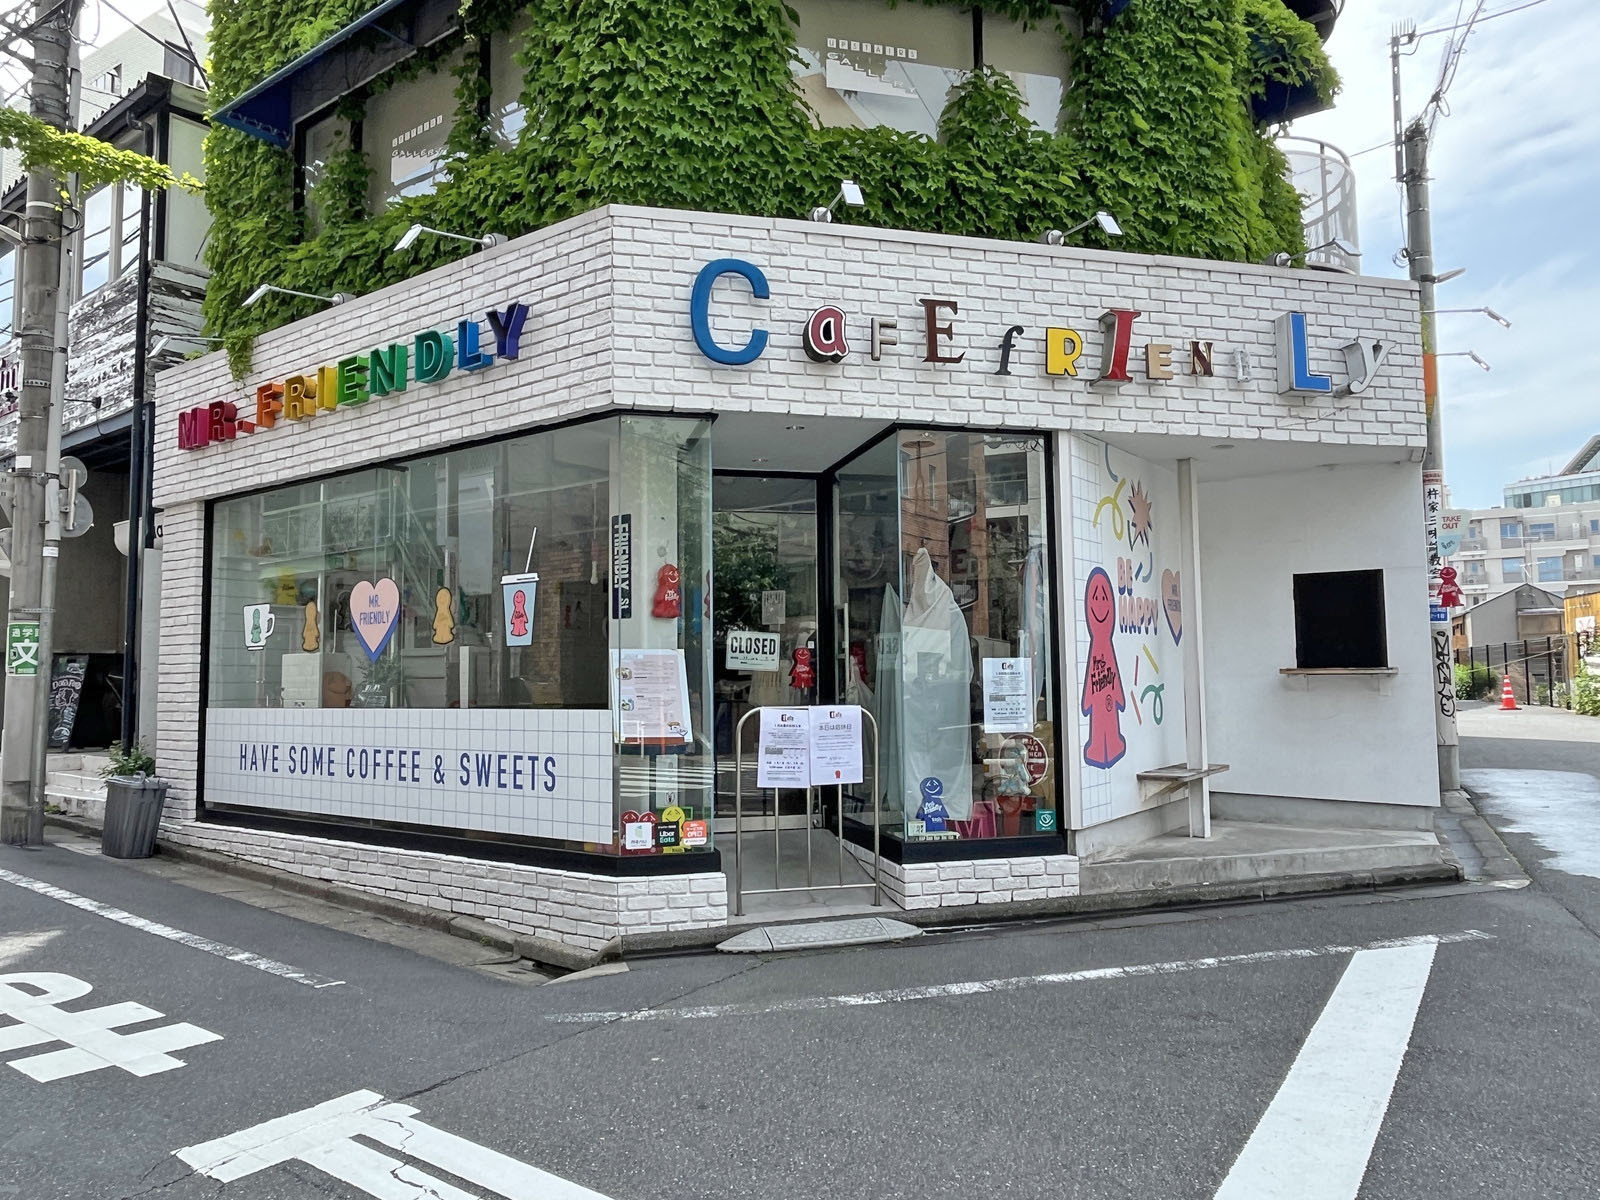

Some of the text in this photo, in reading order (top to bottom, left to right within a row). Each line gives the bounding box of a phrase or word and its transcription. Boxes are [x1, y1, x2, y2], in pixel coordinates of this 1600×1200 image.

[829, 38, 916, 59] UPSTAIRS
[178, 300, 530, 451] MR. FRIENDLY
[614, 523, 629, 590] FRIENDLY
[1117, 556, 1133, 596] BE
[359, 610, 391, 626] FRIENDLY
[1118, 595, 1159, 636] HAPPY
[730, 636, 776, 655] CLOSED
[239, 743, 557, 792] HAVE SOME COFFEE & SWEETS
